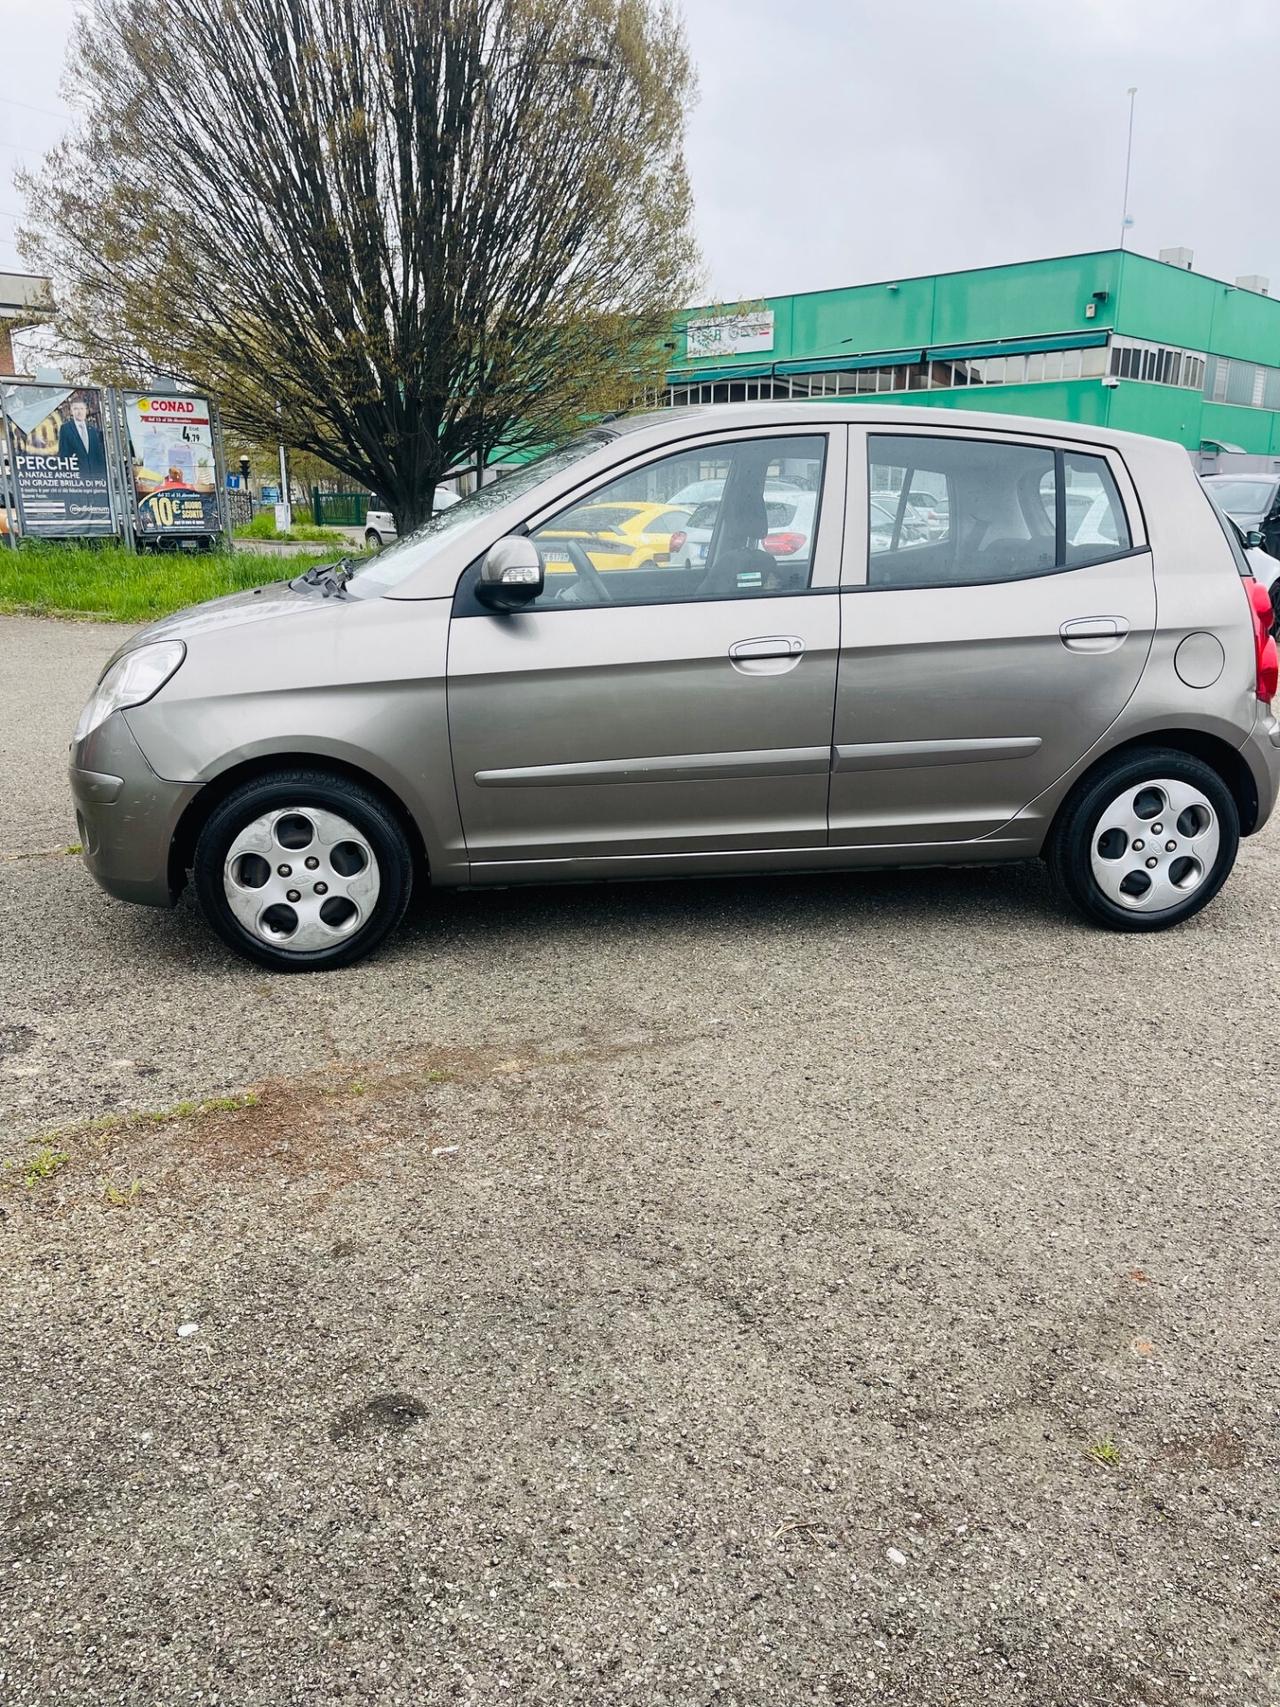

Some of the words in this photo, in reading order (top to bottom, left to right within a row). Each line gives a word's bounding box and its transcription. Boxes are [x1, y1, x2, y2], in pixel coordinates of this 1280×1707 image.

[151, 400, 194, 412] CONAD
[15, 453, 80, 470] PERCHÉ
[95, 479, 107, 487] PIÙ
